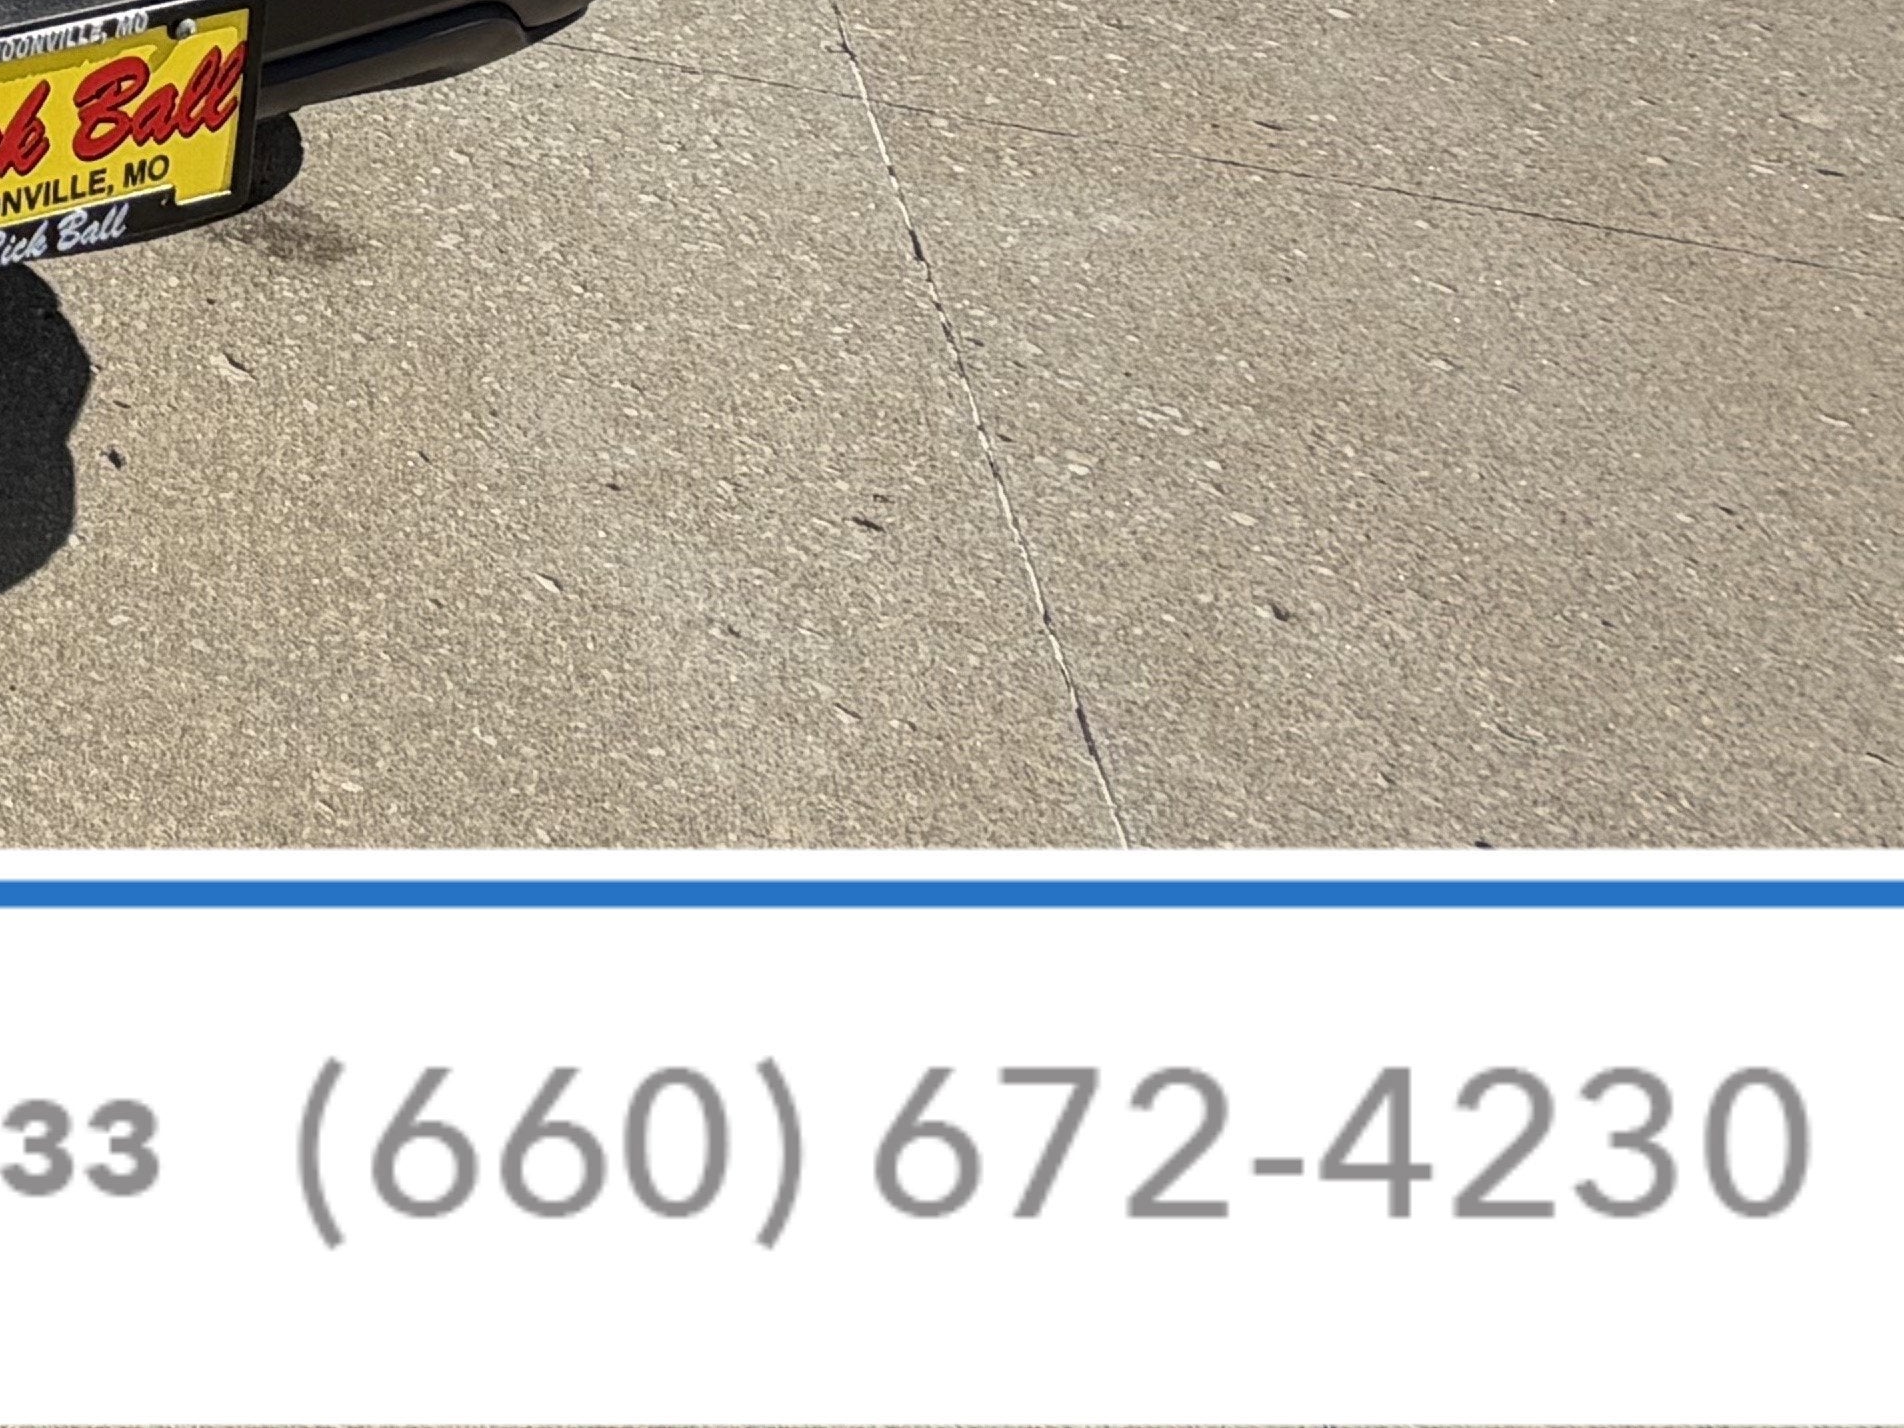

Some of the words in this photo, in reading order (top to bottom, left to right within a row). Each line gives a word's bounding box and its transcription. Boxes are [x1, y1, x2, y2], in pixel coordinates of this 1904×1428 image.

[115, 9, 149, 39] MO
[73, 39, 248, 163] Ball
[123, 153, 170, 187] MO
[56, 203, 128, 254] Ball
